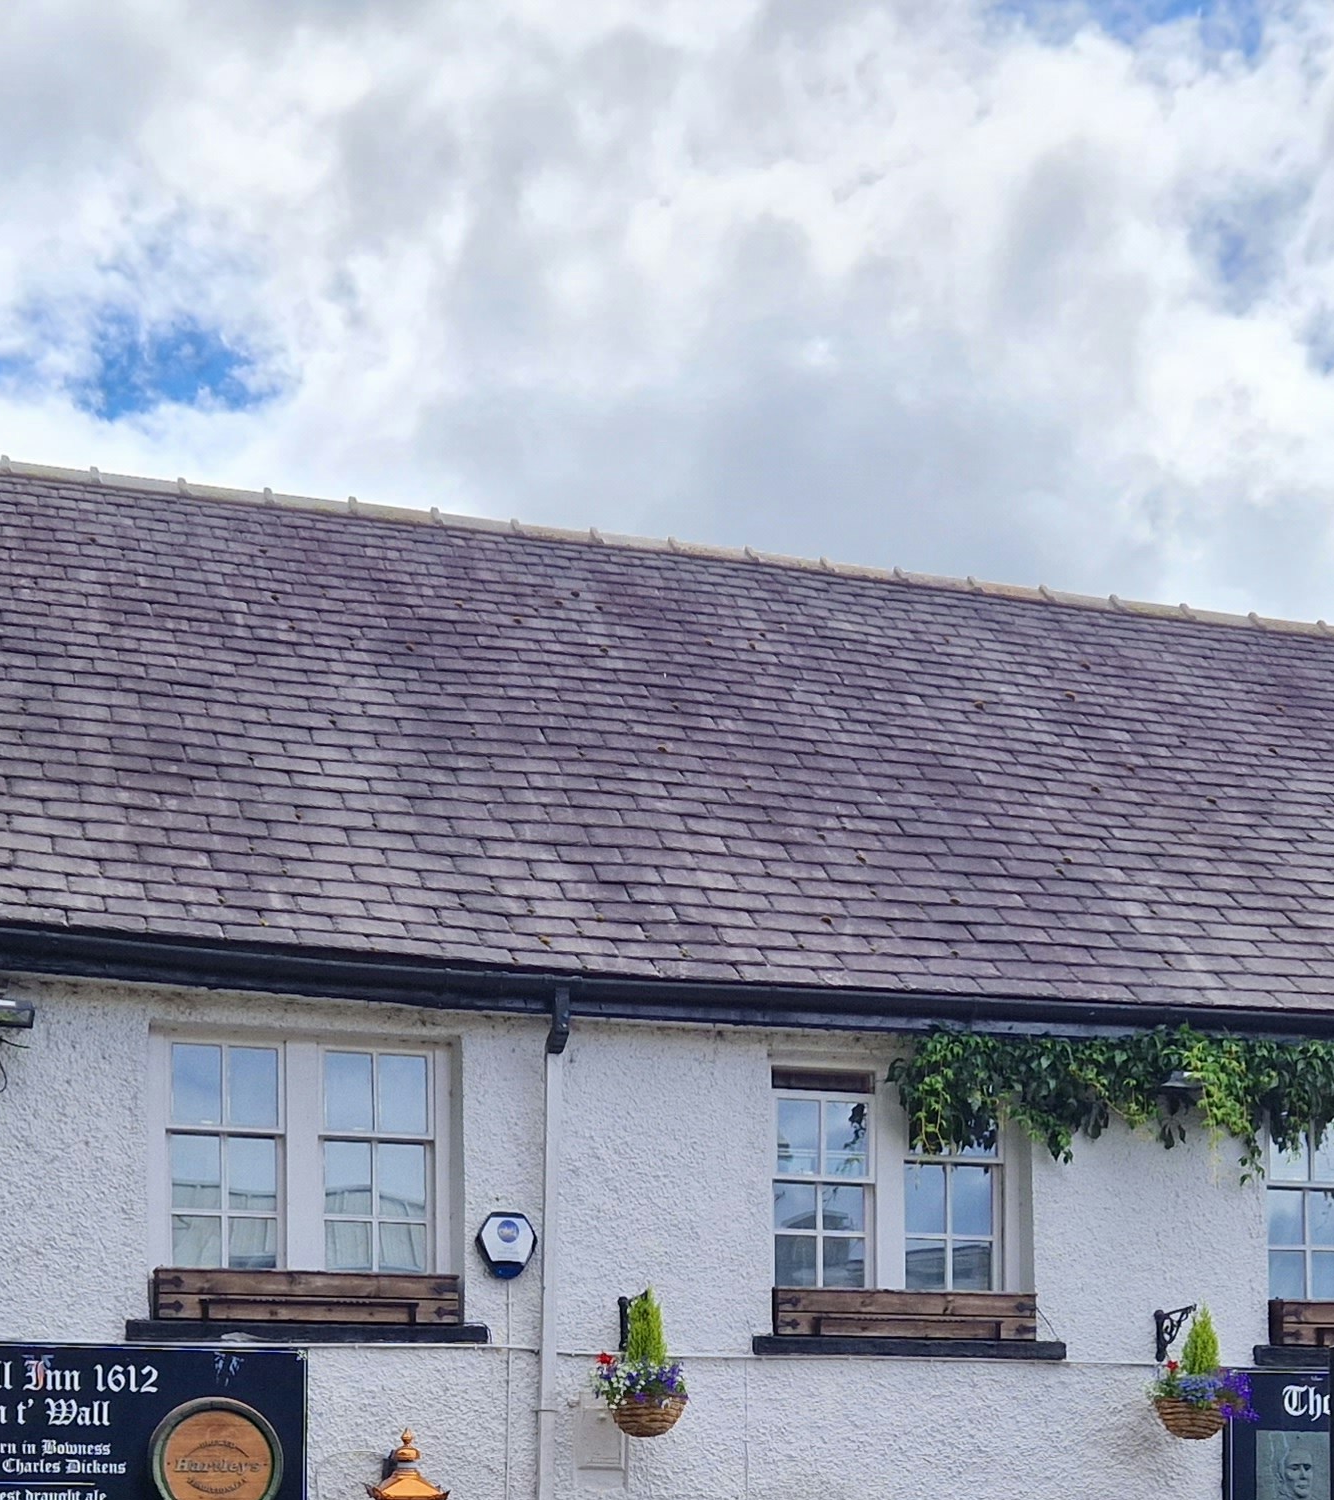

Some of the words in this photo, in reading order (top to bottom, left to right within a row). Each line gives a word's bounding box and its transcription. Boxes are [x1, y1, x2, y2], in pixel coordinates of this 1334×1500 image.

[23, 1360, 81, 1391] Inn
[93, 1364, 159, 1393] 1612
[16, 1398, 35, 1425] t'
[44, 1398, 111, 1426] Wall
[21, 1440, 37, 1455] in
[41, 1439, 111, 1456] Bowness
[2, 1458, 61, 1475] Charles
[65, 1459, 127, 1474] Dickens
